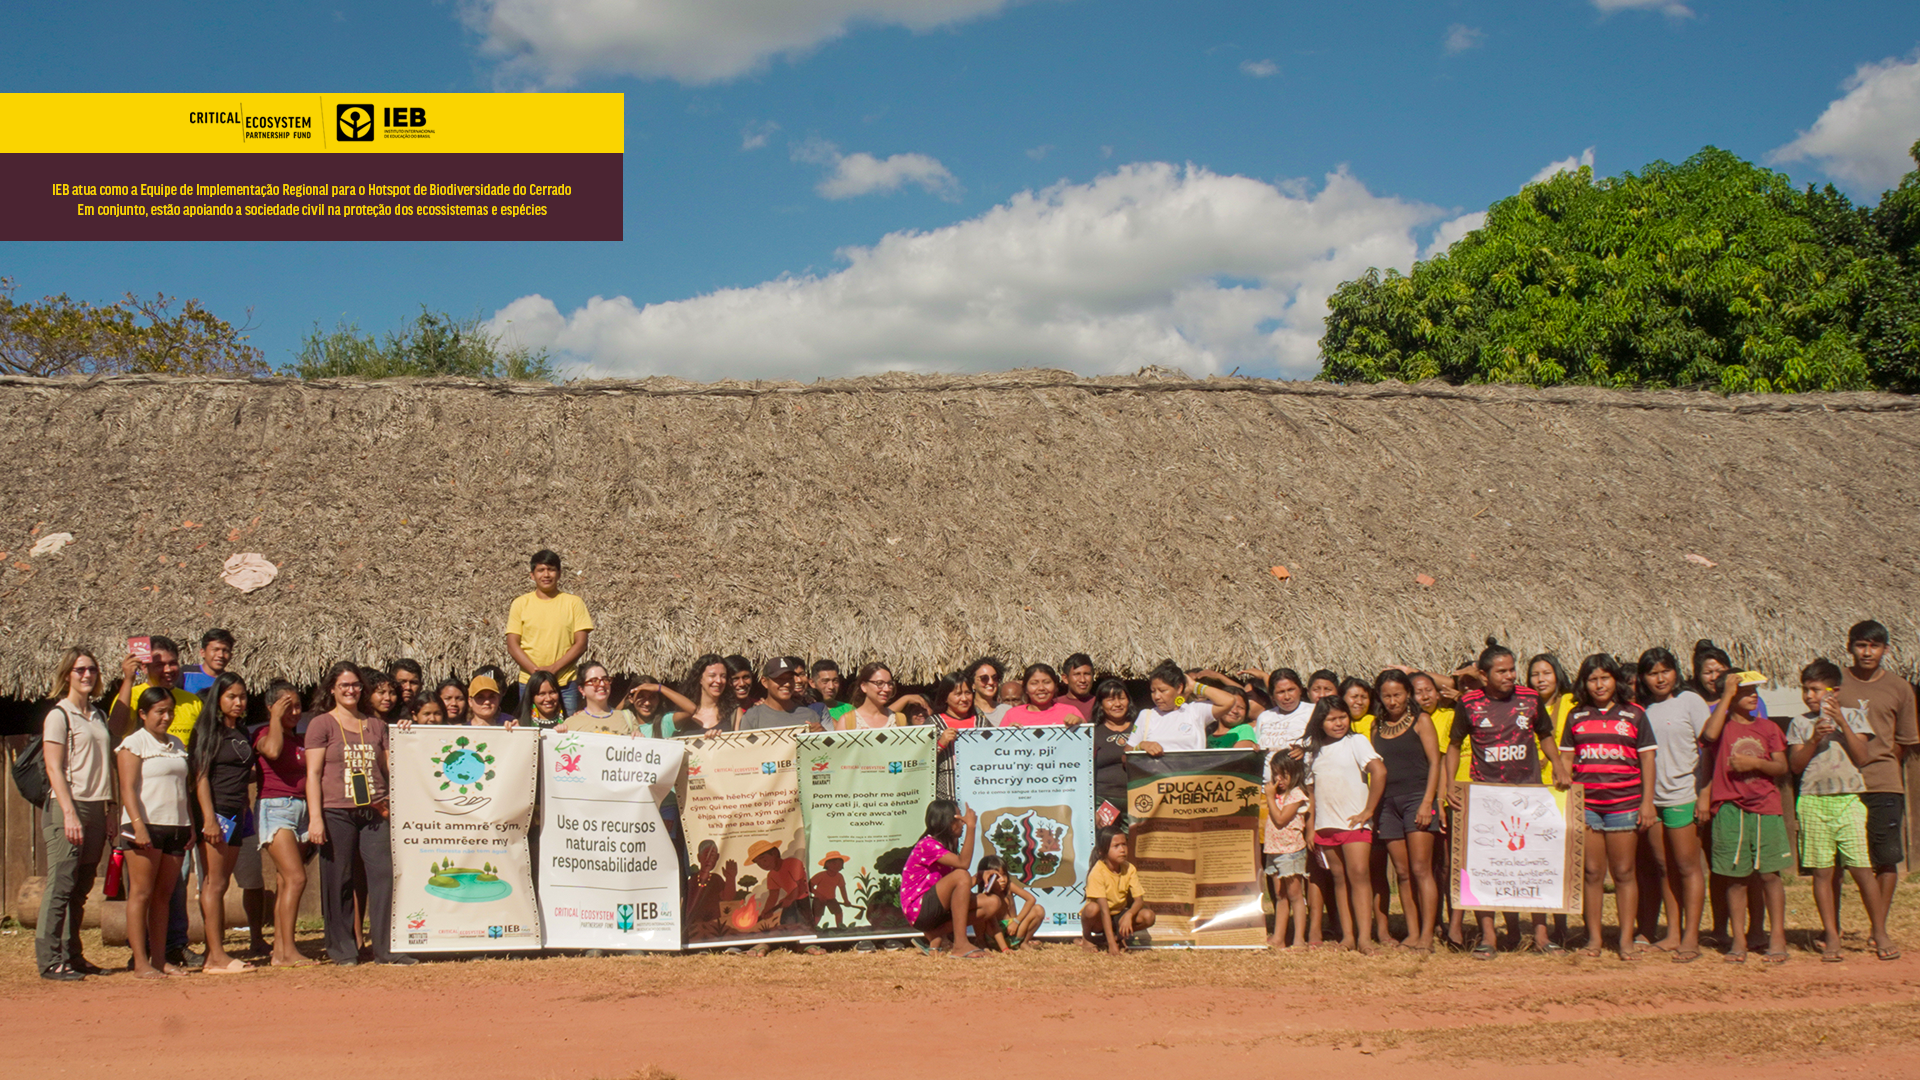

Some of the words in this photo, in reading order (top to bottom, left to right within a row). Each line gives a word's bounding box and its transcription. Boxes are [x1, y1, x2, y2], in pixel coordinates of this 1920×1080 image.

[605, 746, 642, 763] Cuide
[645, 749, 661, 765] da
[994, 747, 1010, 756] Cu
[1014, 748, 1035, 757] my,
[1499, 744, 1527, 762] BRB
[777, 759, 792, 768] IEB
[903, 760, 918, 768] IEB
[1036, 760, 1056, 771] qui
[1059, 761, 1081, 769] nee
[601, 768, 658, 784] natureza
[1026, 776, 1049, 784] noo
[1159, 791, 1233, 805] AMBIENTAL
[811, 801, 833, 810] jamy
[862, 801, 877, 809] qui
[557, 814, 579, 831] Use
[582, 819, 597, 832] os
[601, 820, 656, 833] recursos
[739, 820, 755, 828] paa
[403, 837, 419, 845] cu
[492, 838, 508, 847] my
[566, 836, 616, 852] naturais
[619, 841, 646, 853] com
[552, 855, 658, 873] responsabilidade
[554, 907, 579, 918] CRITICAL
[581, 909, 614, 921] ECOSYSTEM
[636, 902, 659, 920] IEB
[504, 924, 520, 933] IEB
